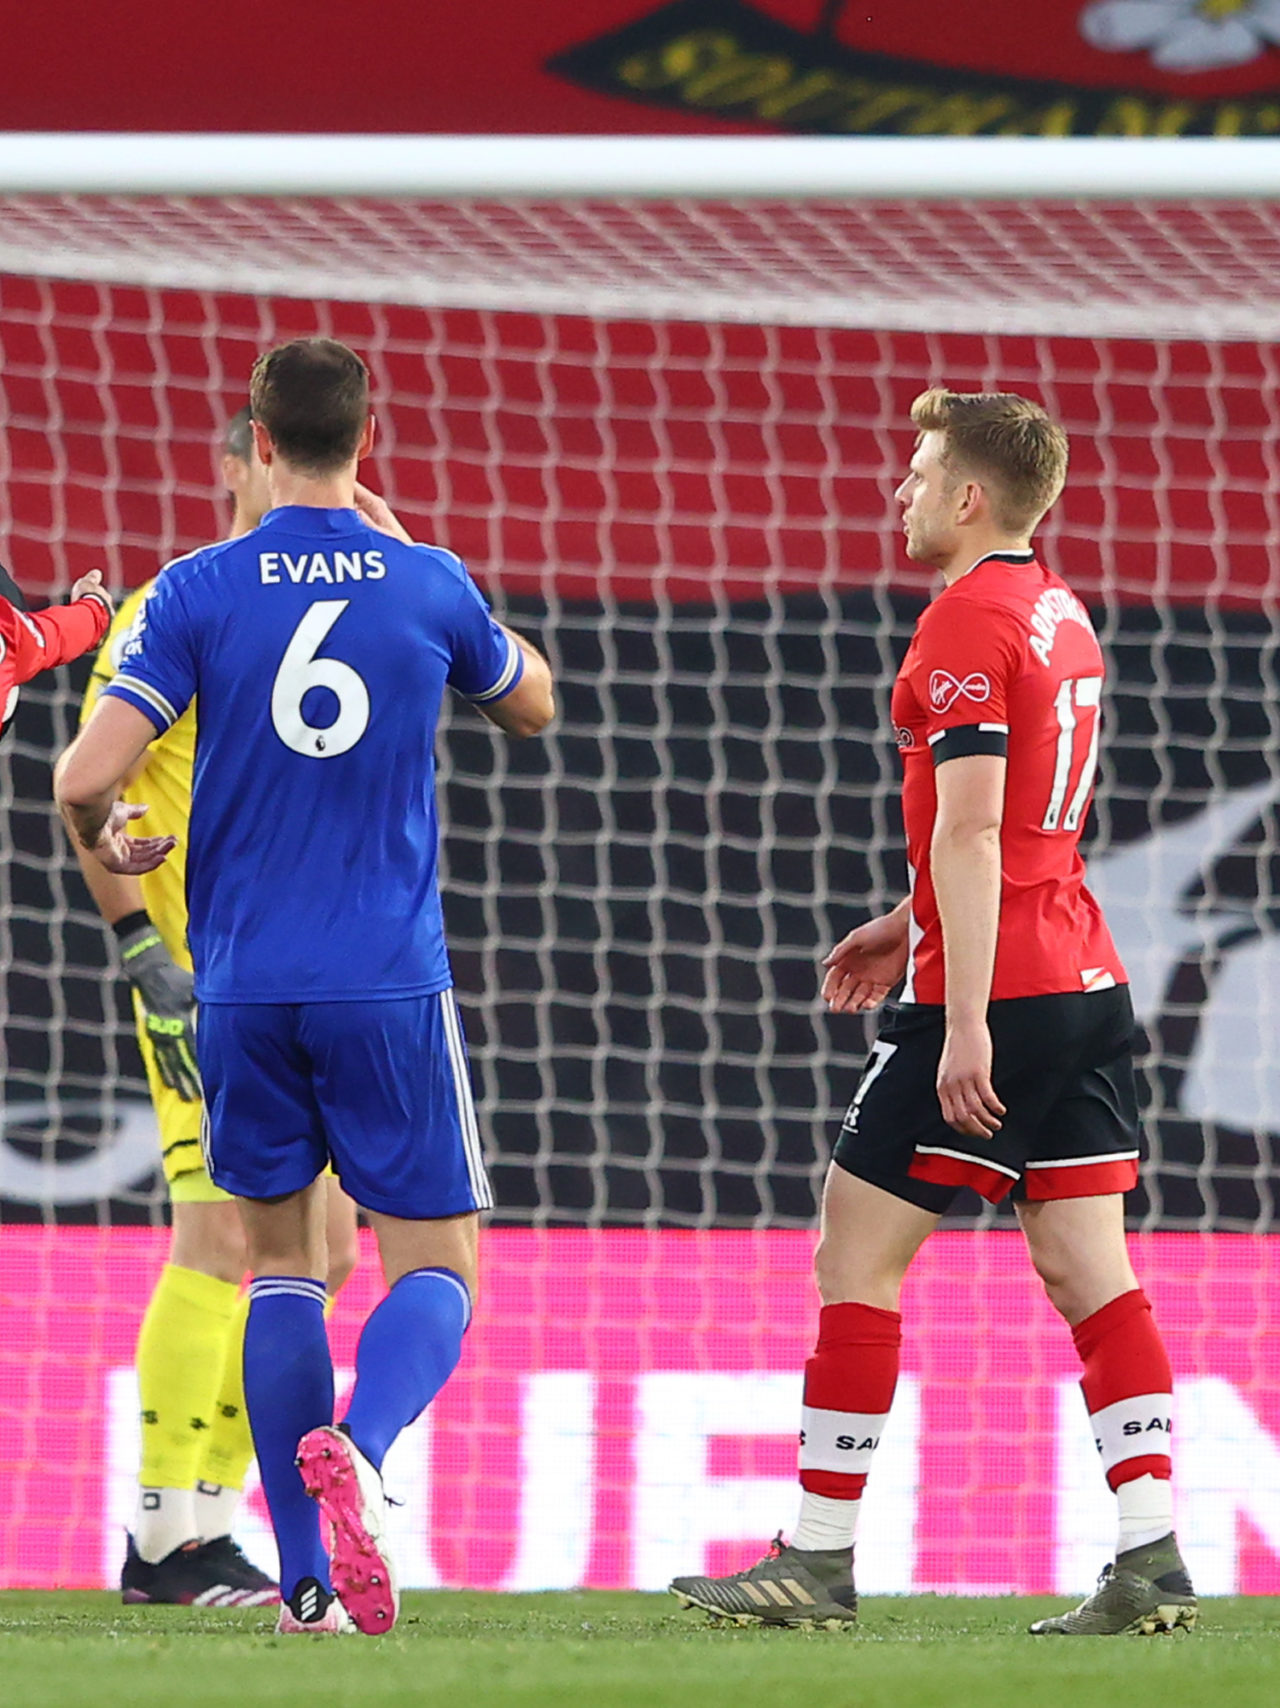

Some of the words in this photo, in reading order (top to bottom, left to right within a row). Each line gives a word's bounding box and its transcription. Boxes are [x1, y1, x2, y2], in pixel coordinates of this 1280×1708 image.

[259, 550, 387, 584] EVANS
[271, 599, 371, 759] 6
[1042, 676, 1102, 832] 17
